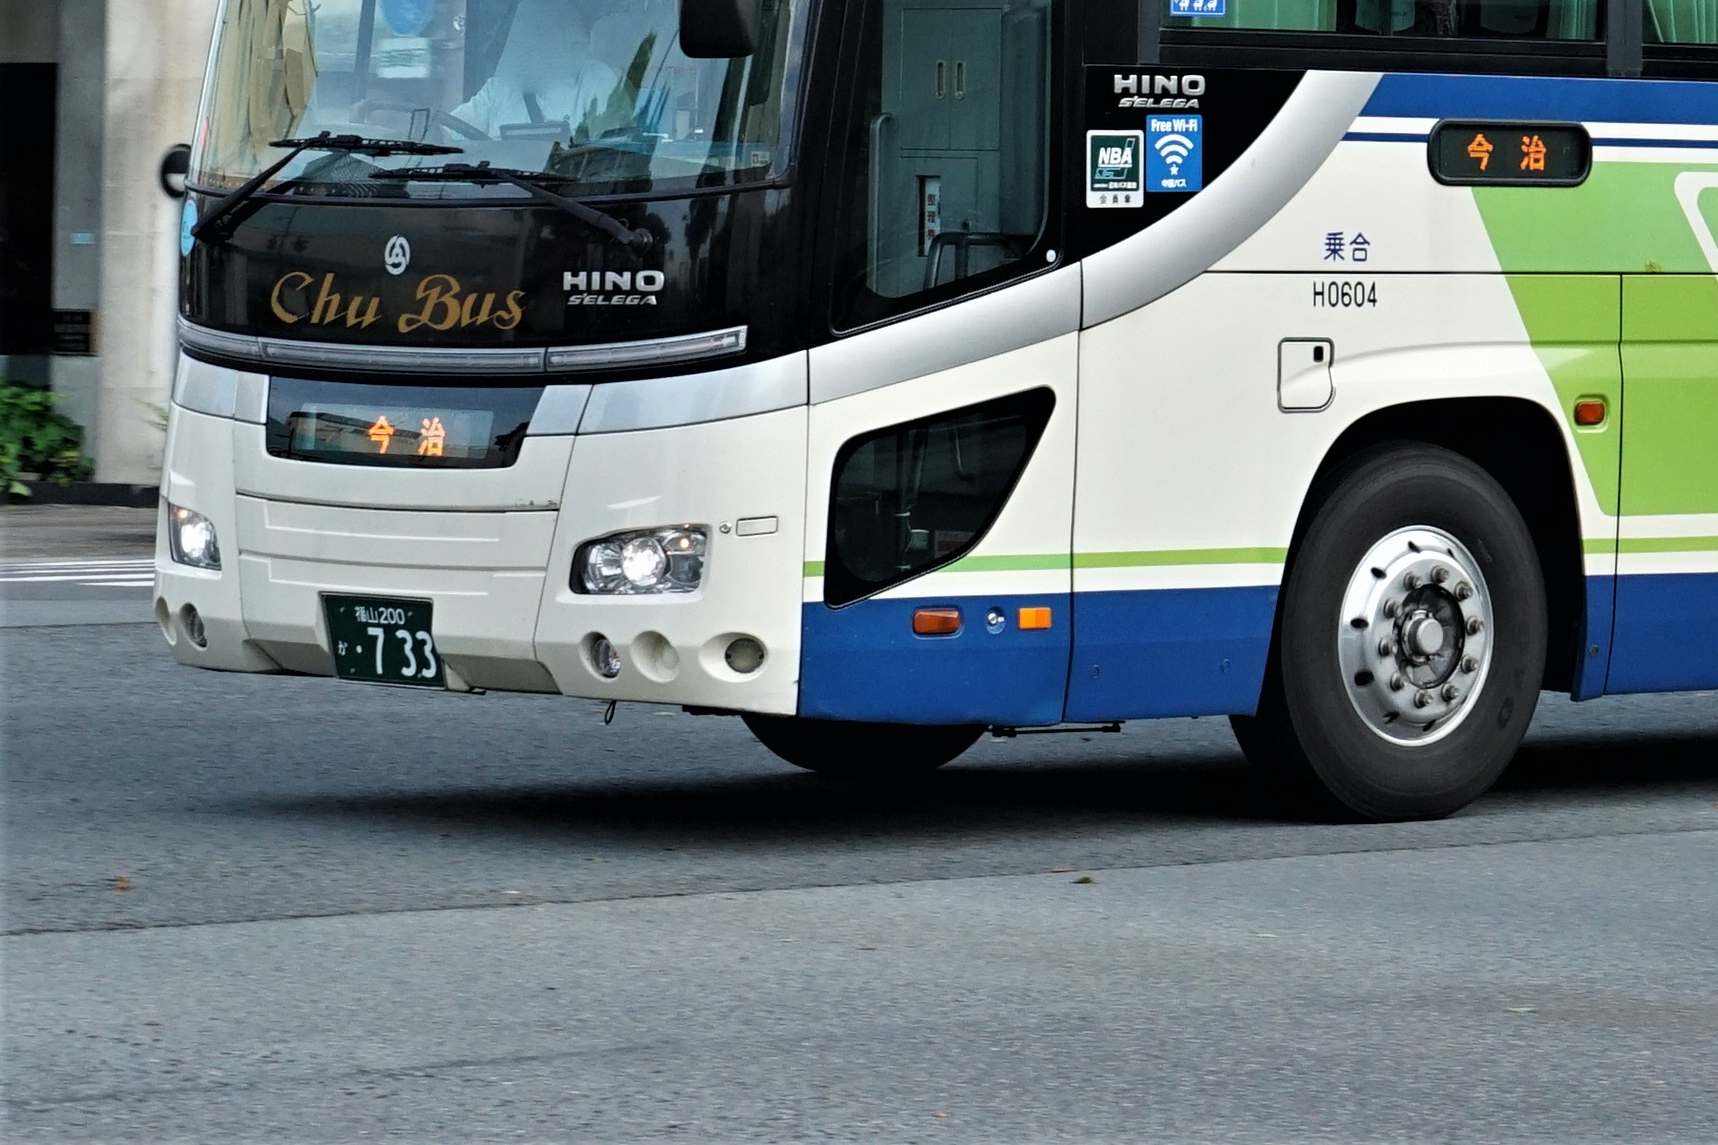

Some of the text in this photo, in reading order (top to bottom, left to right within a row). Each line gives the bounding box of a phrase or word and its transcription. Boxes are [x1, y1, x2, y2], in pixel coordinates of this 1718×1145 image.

[1114, 74, 1206, 96] HINO
[1118, 96, 1200, 108] SELEGA
[1151, 119, 1198, 132] Free Wi-Fi
[1098, 147, 1133, 166] NBA
[1467, 134, 1547, 171] 今治
[1324, 231, 1371, 262] 乗合
[563, 270, 665, 292] HINO
[271, 271, 527, 334] Chu Bus
[567, 293, 658, 306] SELEGA
[1313, 281, 1378, 308] H0604
[368, 415, 446, 457] 今治
